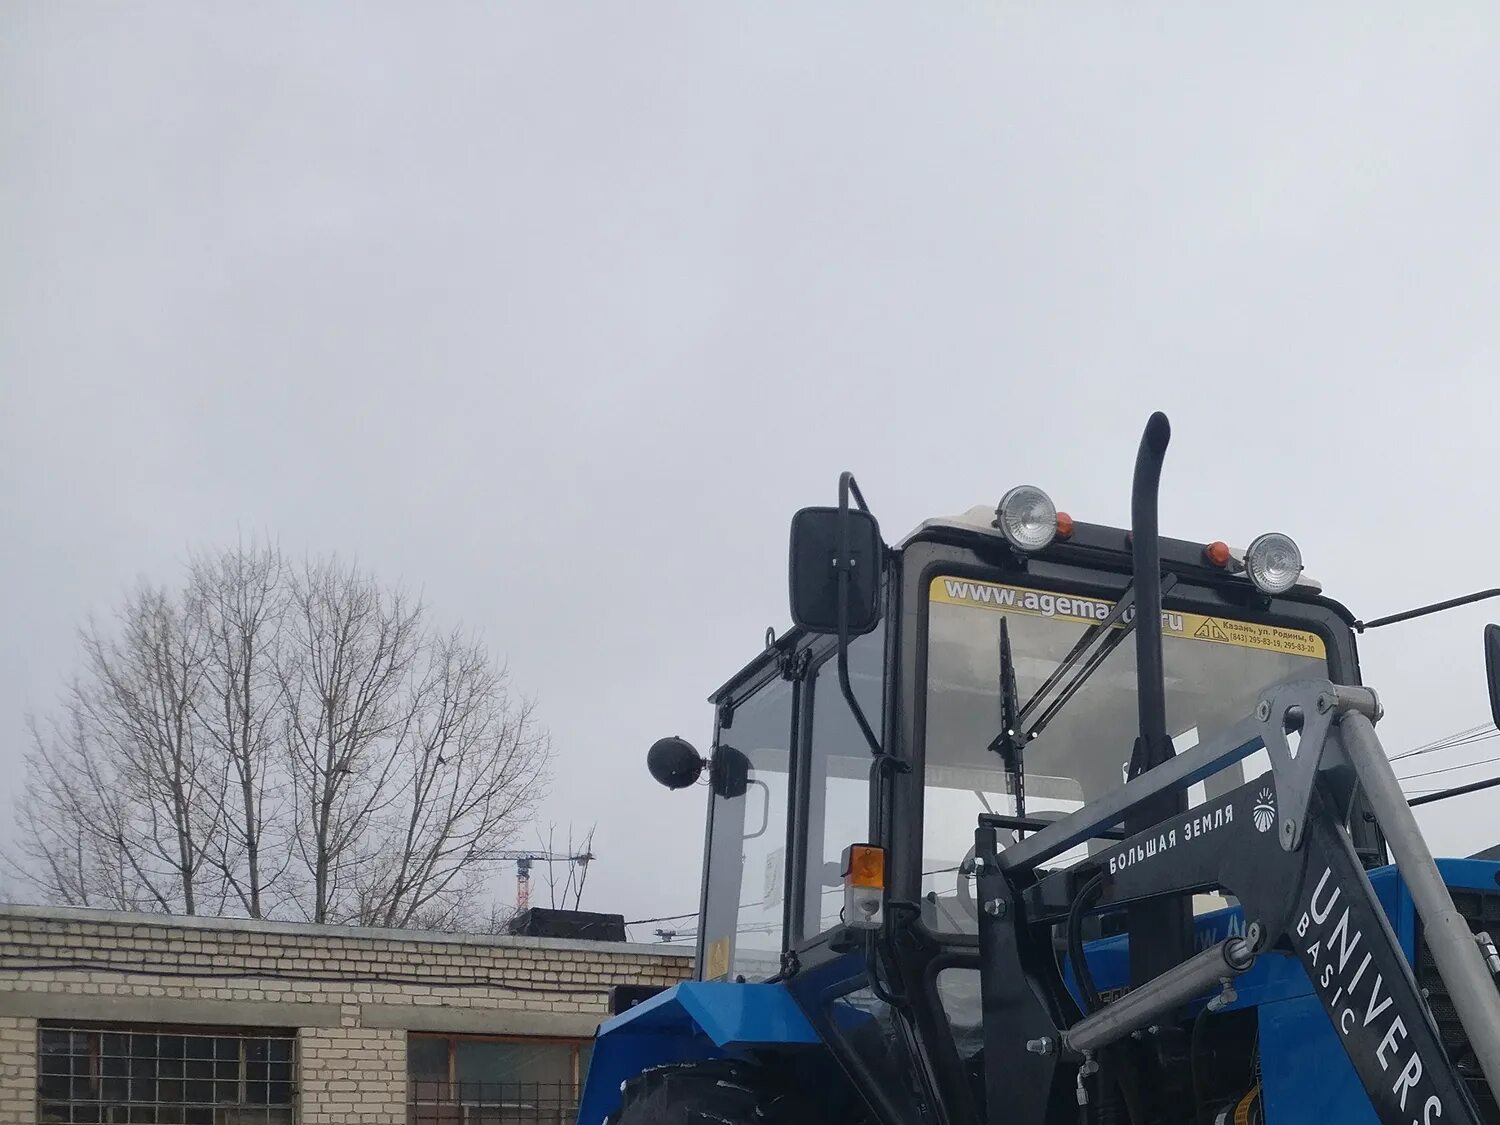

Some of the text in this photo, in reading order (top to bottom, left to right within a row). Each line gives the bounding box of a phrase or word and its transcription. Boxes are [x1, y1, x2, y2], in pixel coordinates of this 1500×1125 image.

[1222, 621, 1256, 635] Казань,
[1258, 628, 1271, 636] ул.
[1273, 630, 1307, 642] Родины,
[1229, 632, 1248, 643] (843)
[1109, 804, 1234, 875] БОЛЬШАЯ ЗЕМЛЯ
[1296, 911, 1356, 1036] BASIC
